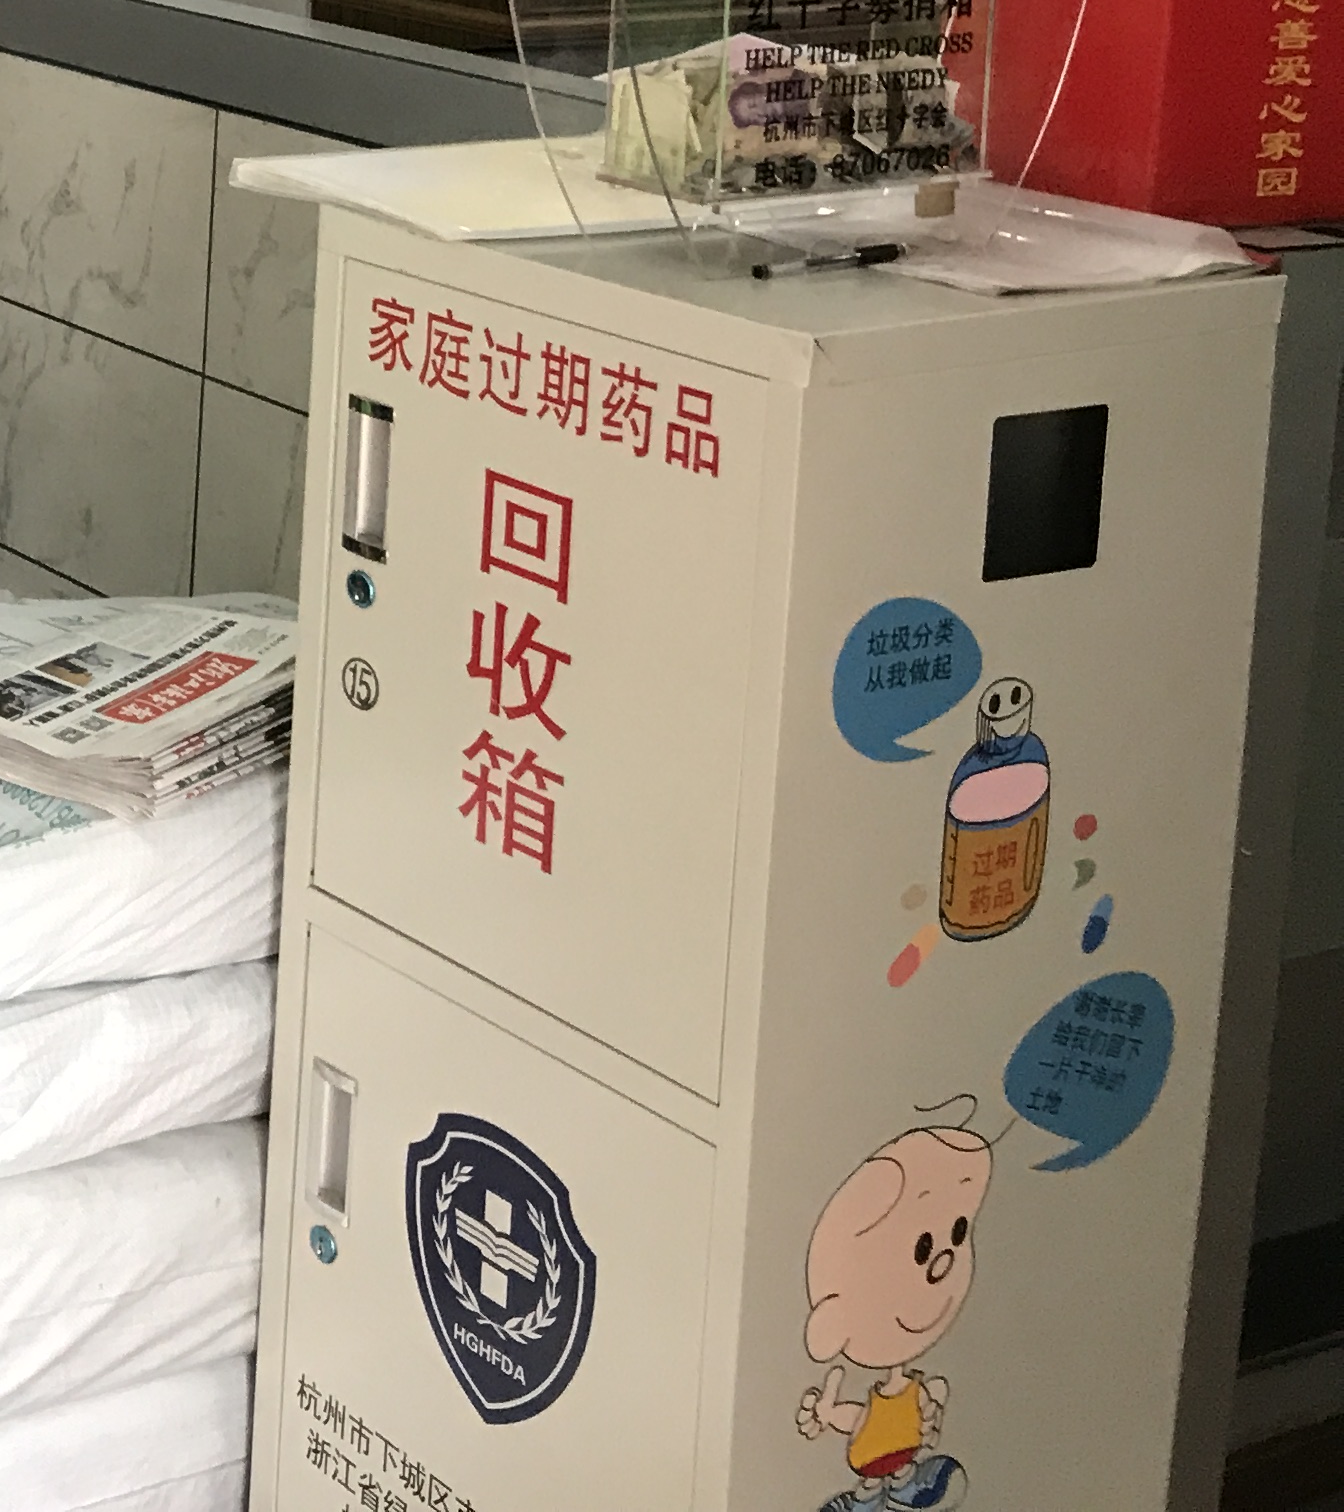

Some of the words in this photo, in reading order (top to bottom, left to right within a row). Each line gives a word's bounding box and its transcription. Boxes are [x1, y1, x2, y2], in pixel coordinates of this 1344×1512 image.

[745, 45, 802, 71] HELP
[808, 41, 851, 65] THE
[856, 38, 901, 62] RED
[904, 31, 974, 57] CROSS
[766, 79, 823, 104] HELP
[828, 73, 871, 98] THE
[876, 67, 949, 93] NEEDY
[368, 297, 720, 478] 家庭过期药品
[866, 618, 955, 658] 垃圾分类
[457, 468, 573, 875] 回收箱
[863, 652, 953, 693] 从我做起
[970, 840, 1019, 878] 过期
[968, 879, 1016, 916] 药品
[1051, 1020, 1143, 1061] 给我们留下
[1037, 1056, 1128, 1094] 一片干净的
[1025, 1085, 1064, 1117] 土地
[453, 1322, 526, 1386] HGHFDA
